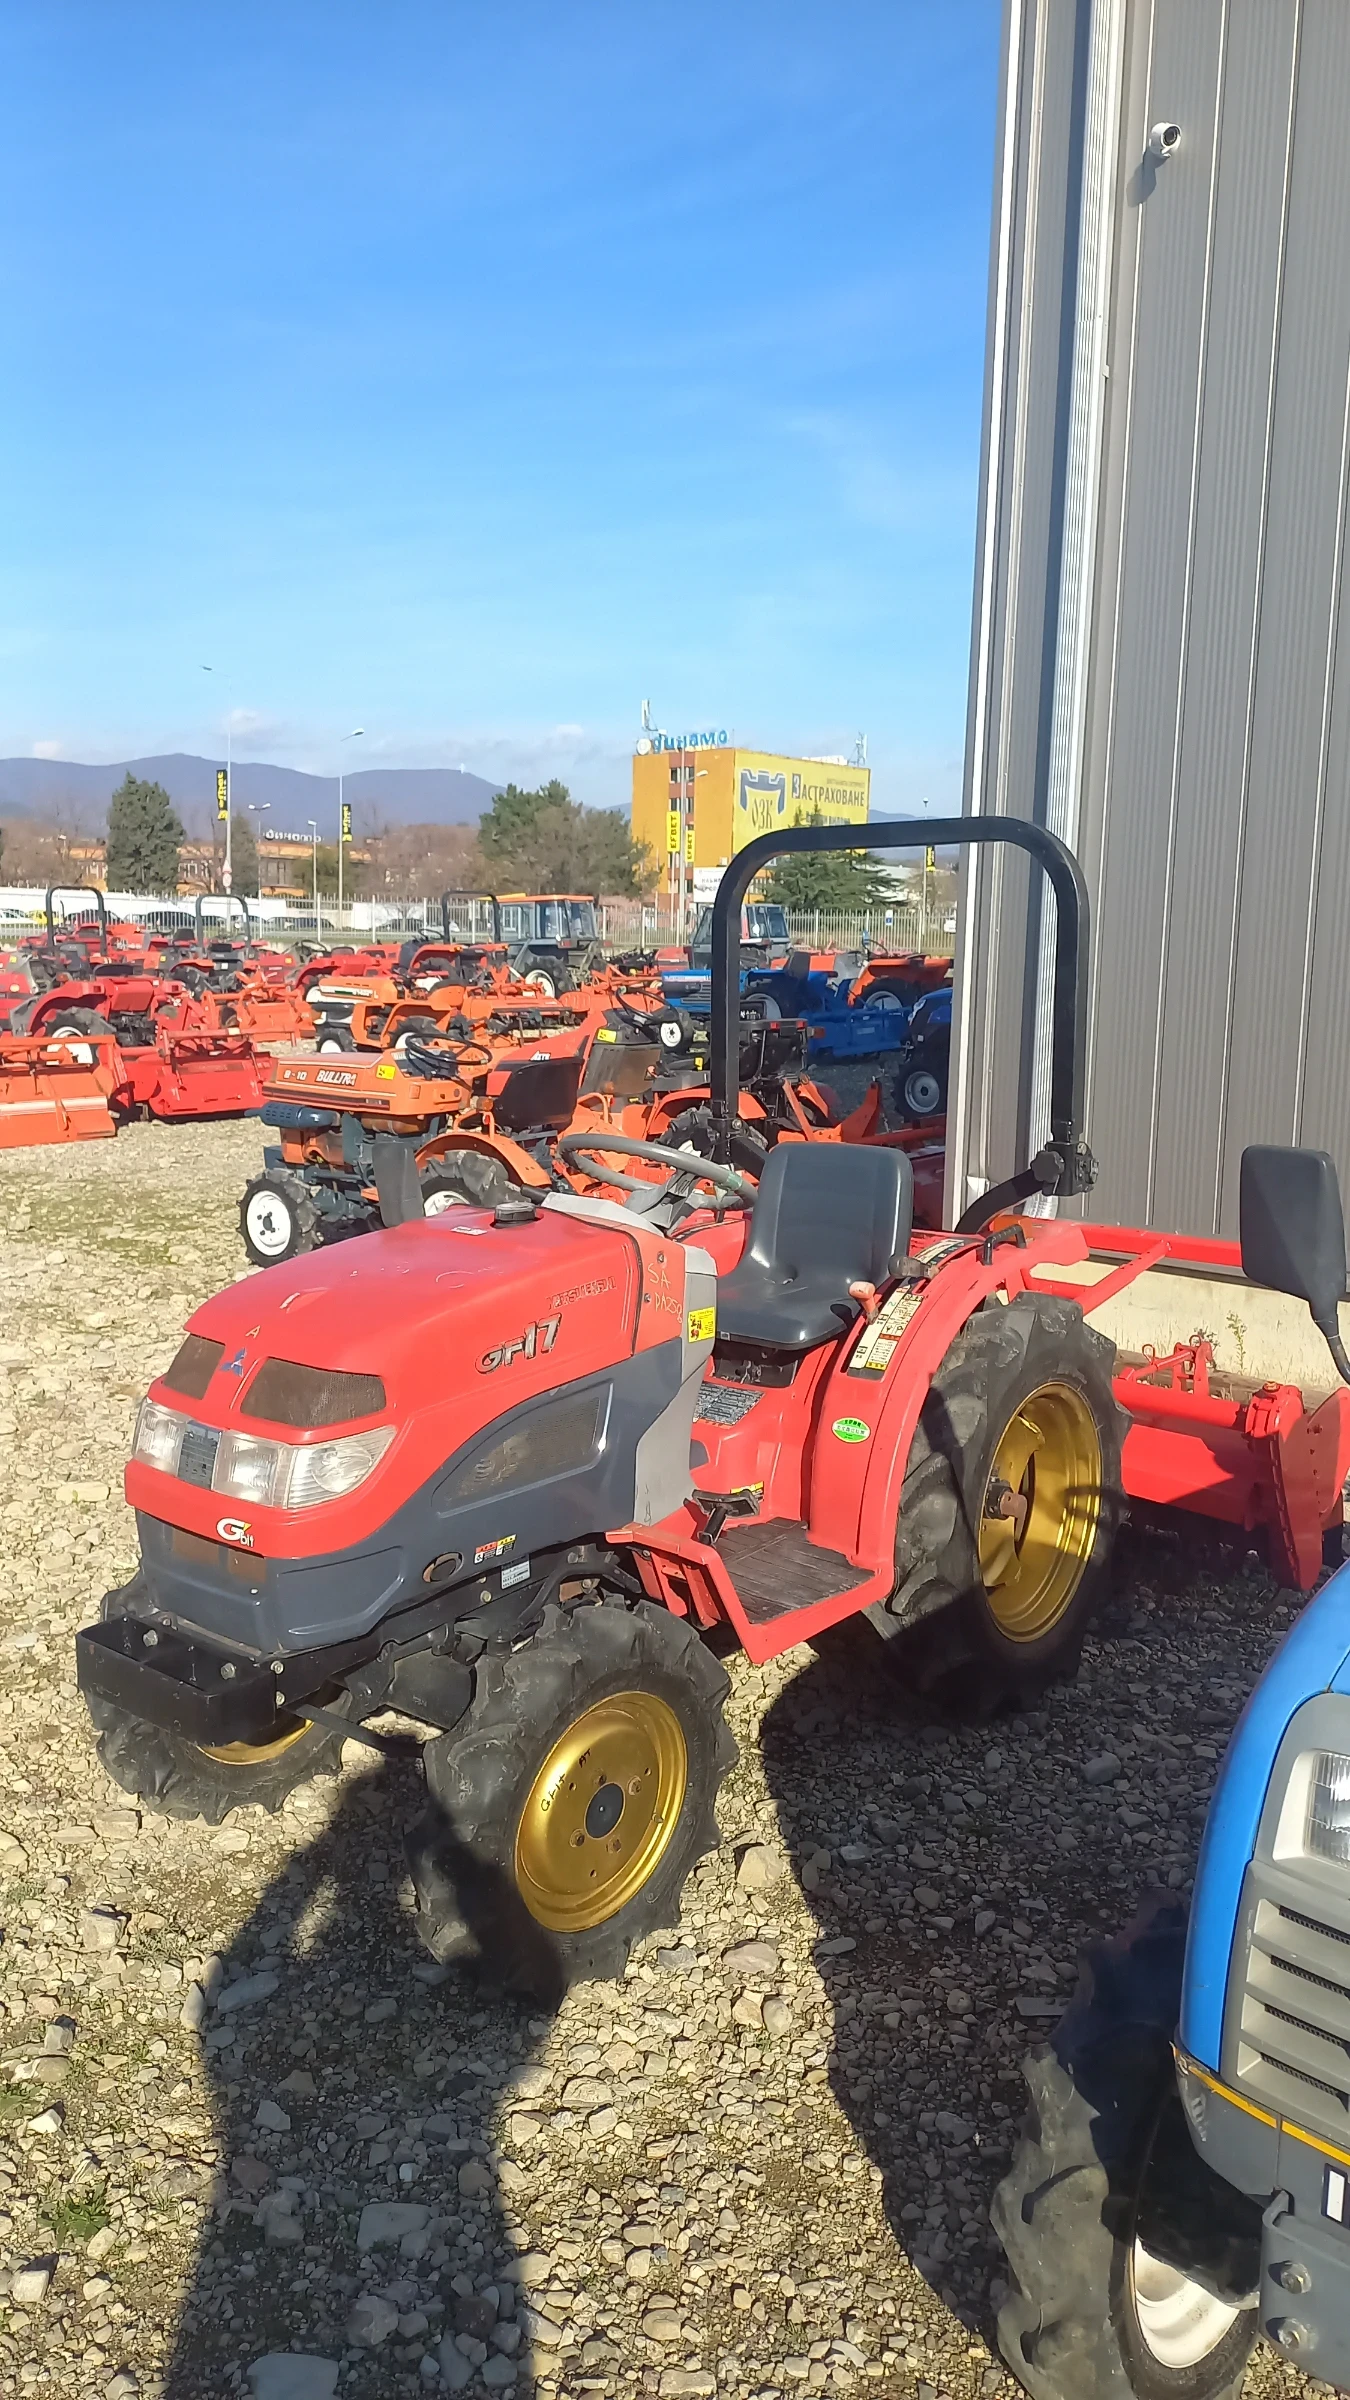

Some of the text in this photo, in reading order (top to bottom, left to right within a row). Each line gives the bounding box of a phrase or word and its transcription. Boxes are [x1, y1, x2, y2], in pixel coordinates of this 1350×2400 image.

[792, 773, 865, 807] ЗАСТРАХОВАНЕ
[315, 1068, 358, 1086] BULLTRA
[475, 1312, 562, 1374] GF17
